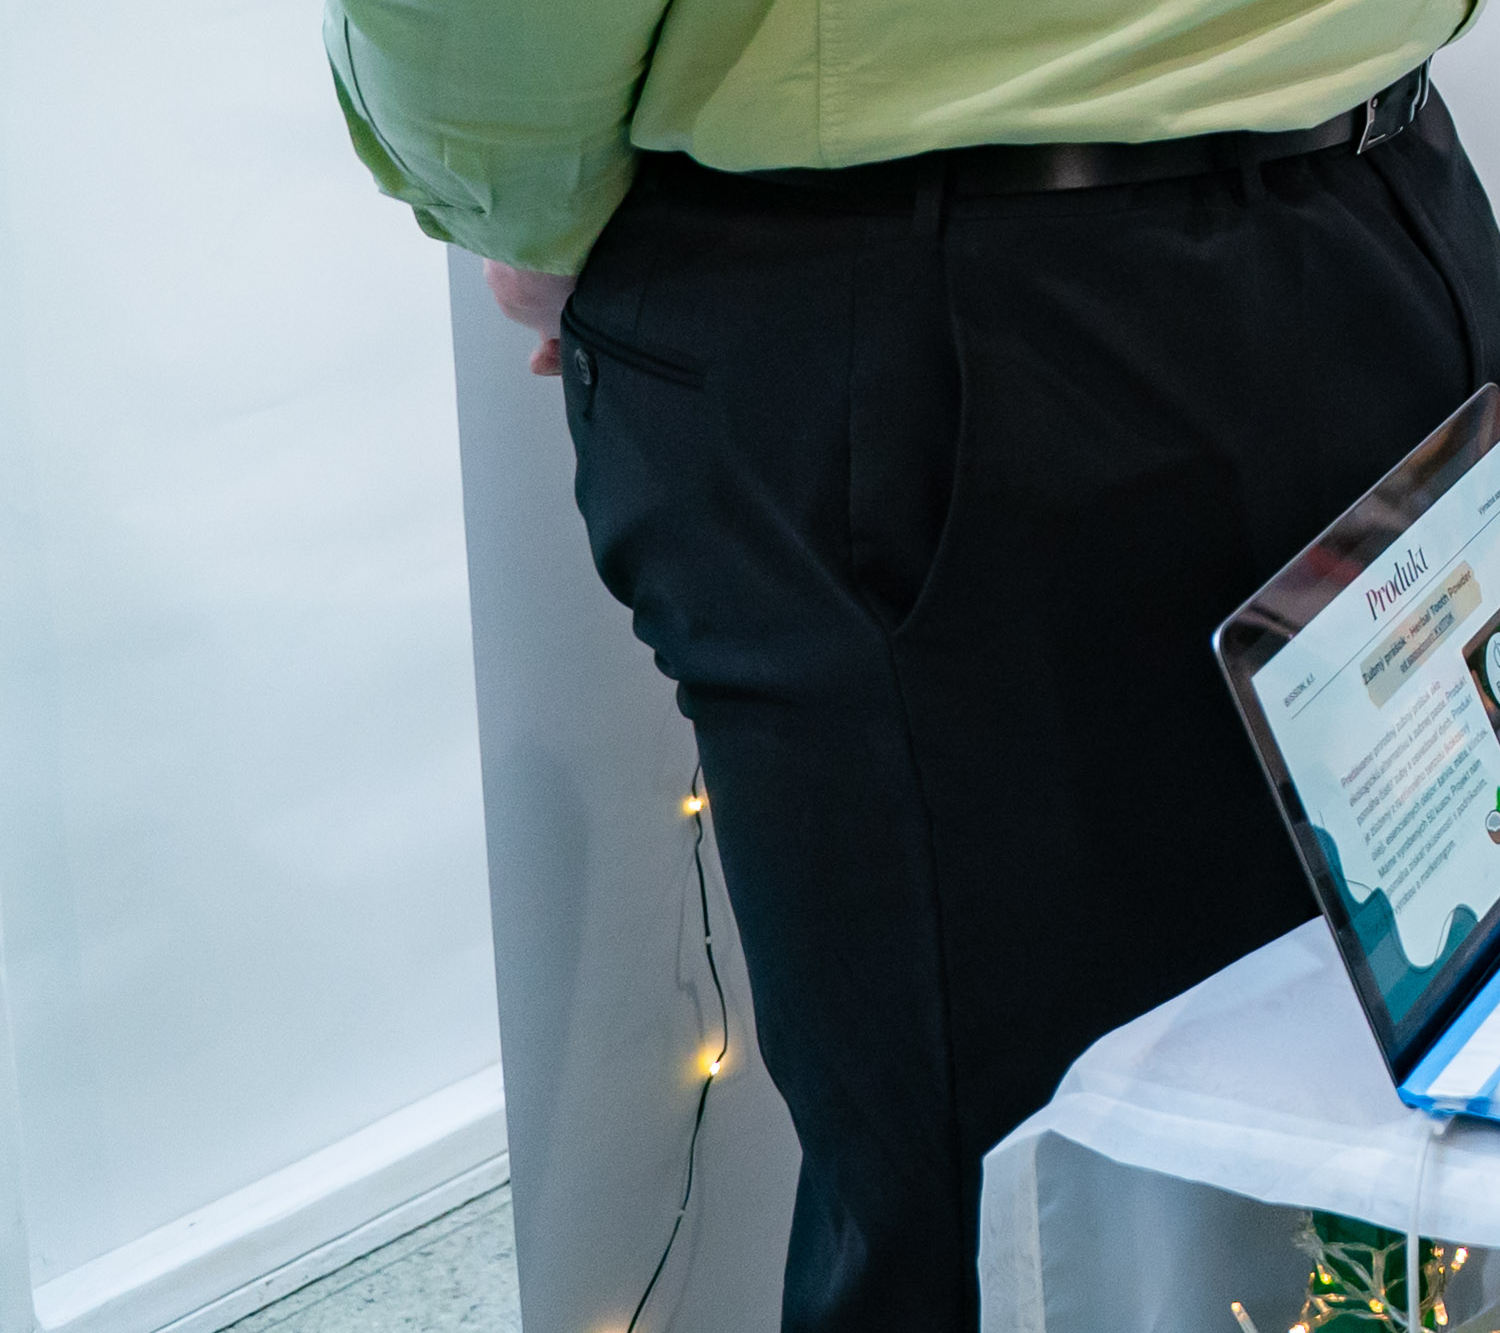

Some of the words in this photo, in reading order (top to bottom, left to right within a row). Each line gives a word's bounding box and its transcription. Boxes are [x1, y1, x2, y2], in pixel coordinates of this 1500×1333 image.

[1364, 543, 1430, 621] Produkt
[1408, 609, 1432, 638] Herbal
[1429, 591, 1449, 617] Tooth
[1446, 568, 1472, 599] Powder
